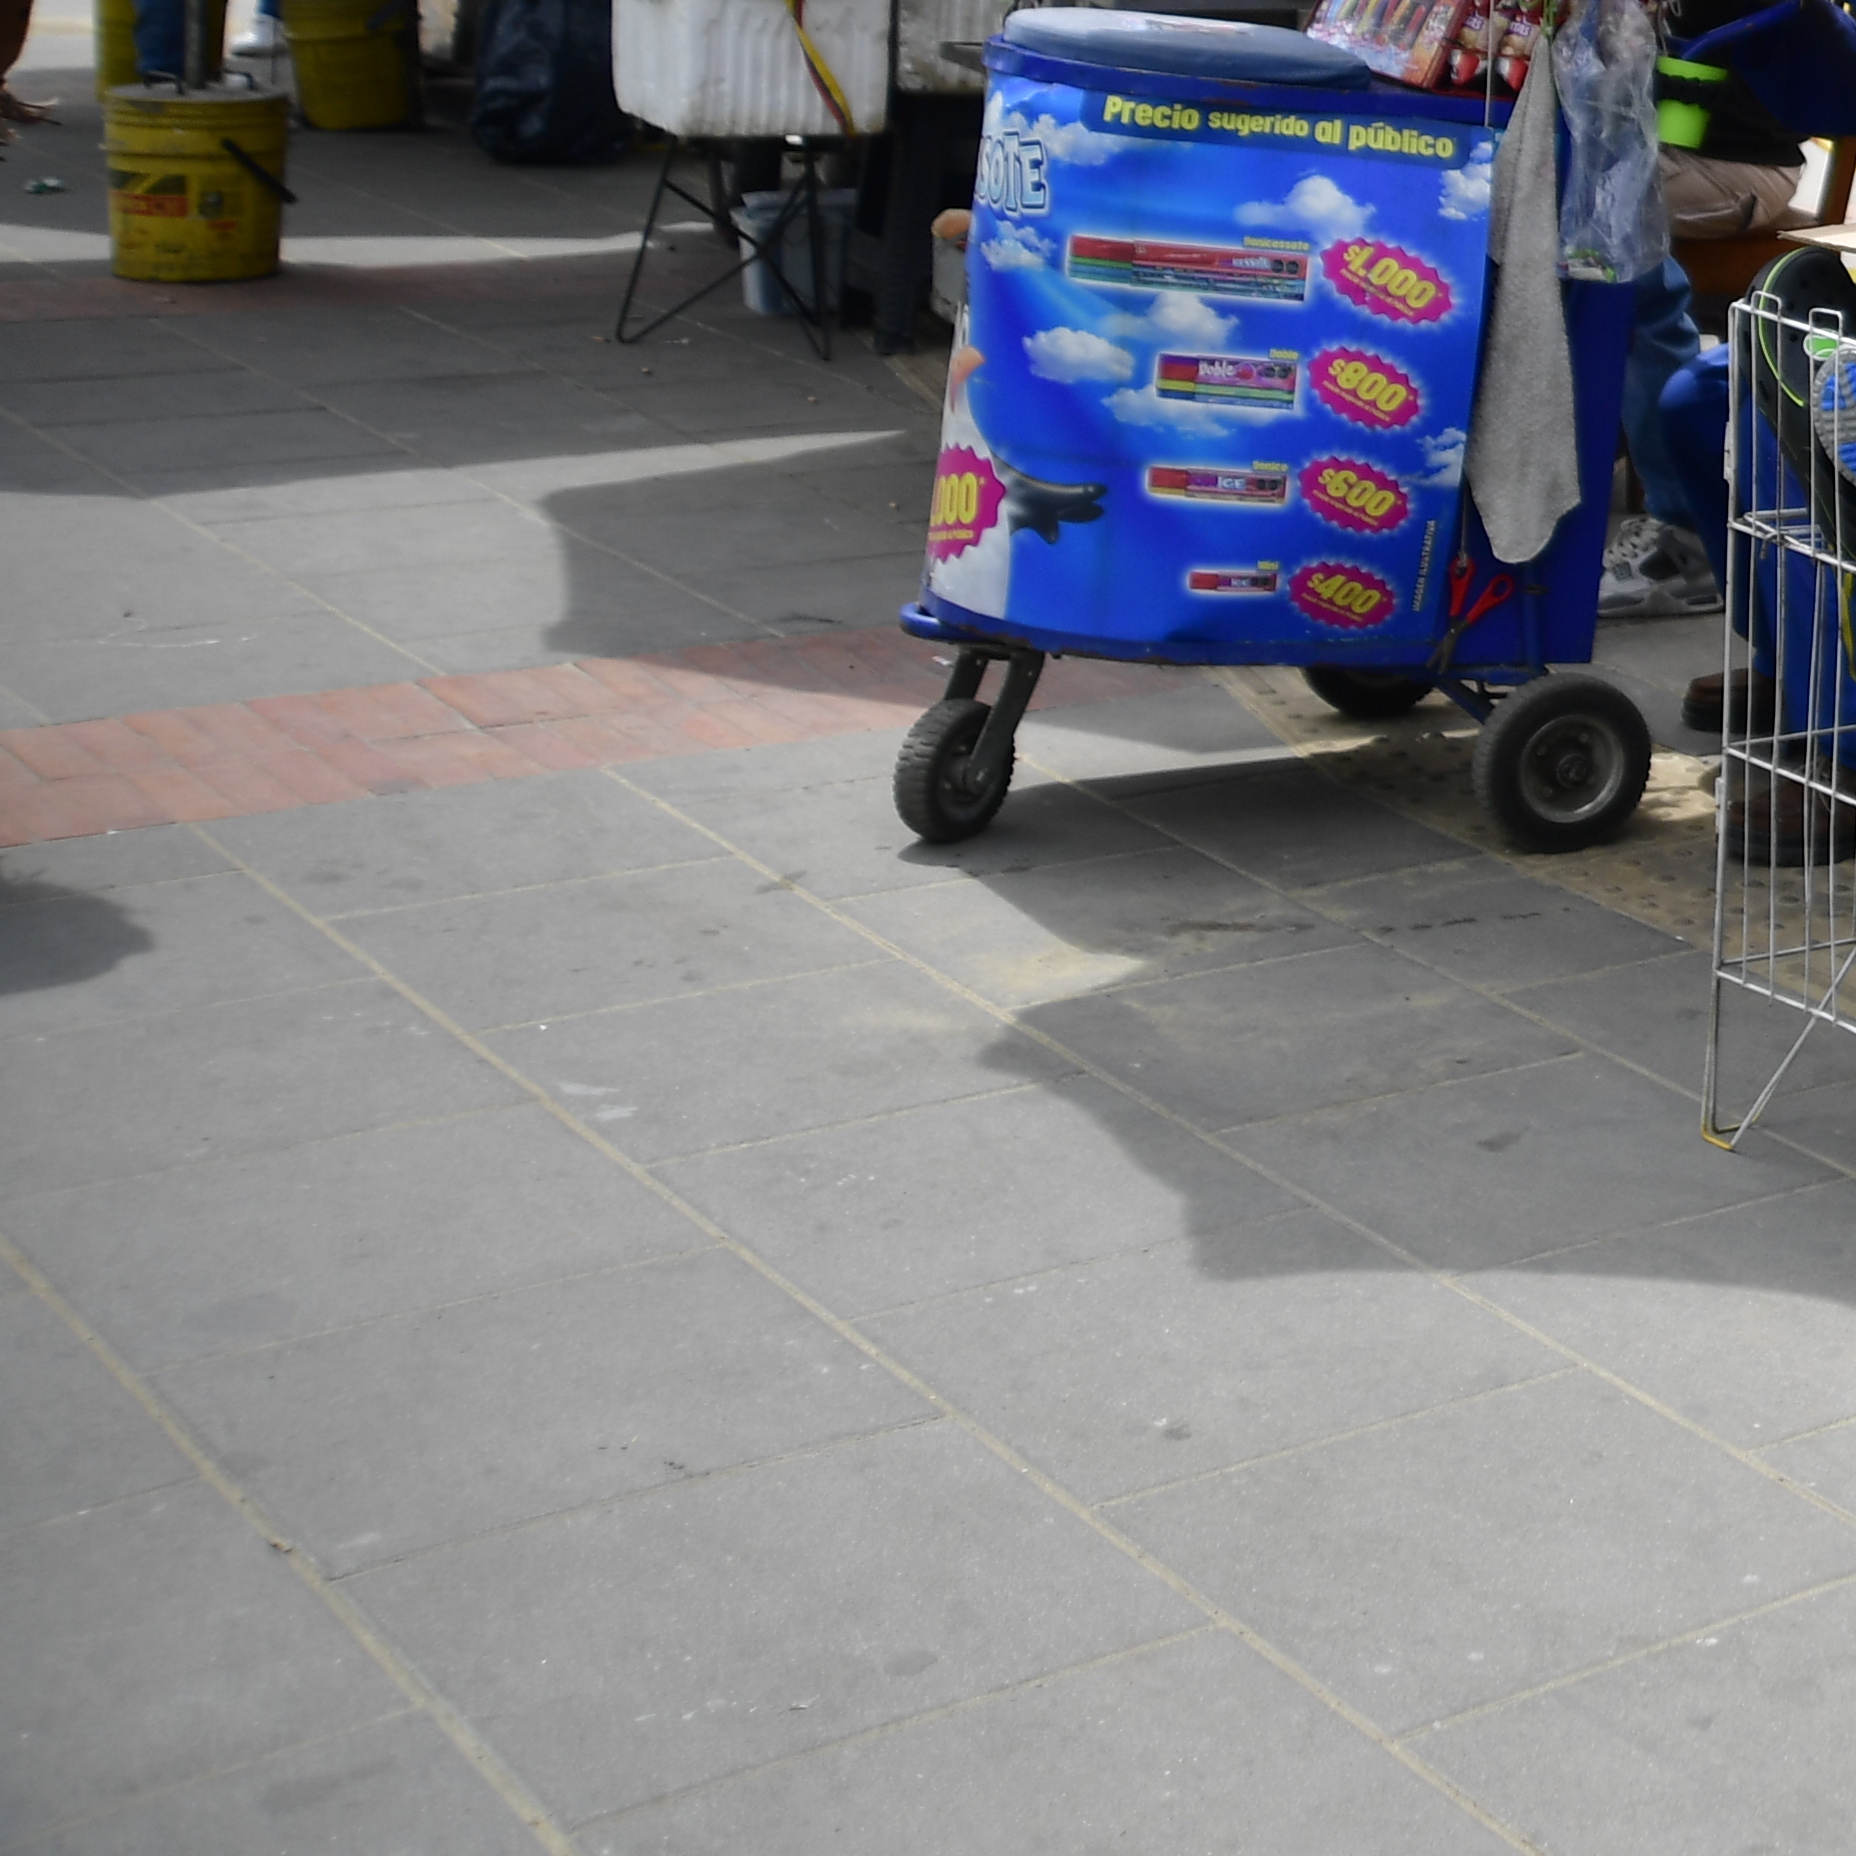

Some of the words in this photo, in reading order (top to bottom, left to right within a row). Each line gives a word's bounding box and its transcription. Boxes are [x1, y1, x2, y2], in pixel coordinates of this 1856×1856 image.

[1103, 95, 1200, 131] Precio
[1207, 109, 1309, 140] sugerido
[1314, 120, 1341, 145] al
[1348, 121, 1455, 159] público
[976, 132, 1048, 215] SOTE
[1198, 360, 1235, 378] Doble
[1327, 358, 1408, 412] $800
[1318, 468, 1396, 517] $600
[1306, 572, 1382, 614] $400
